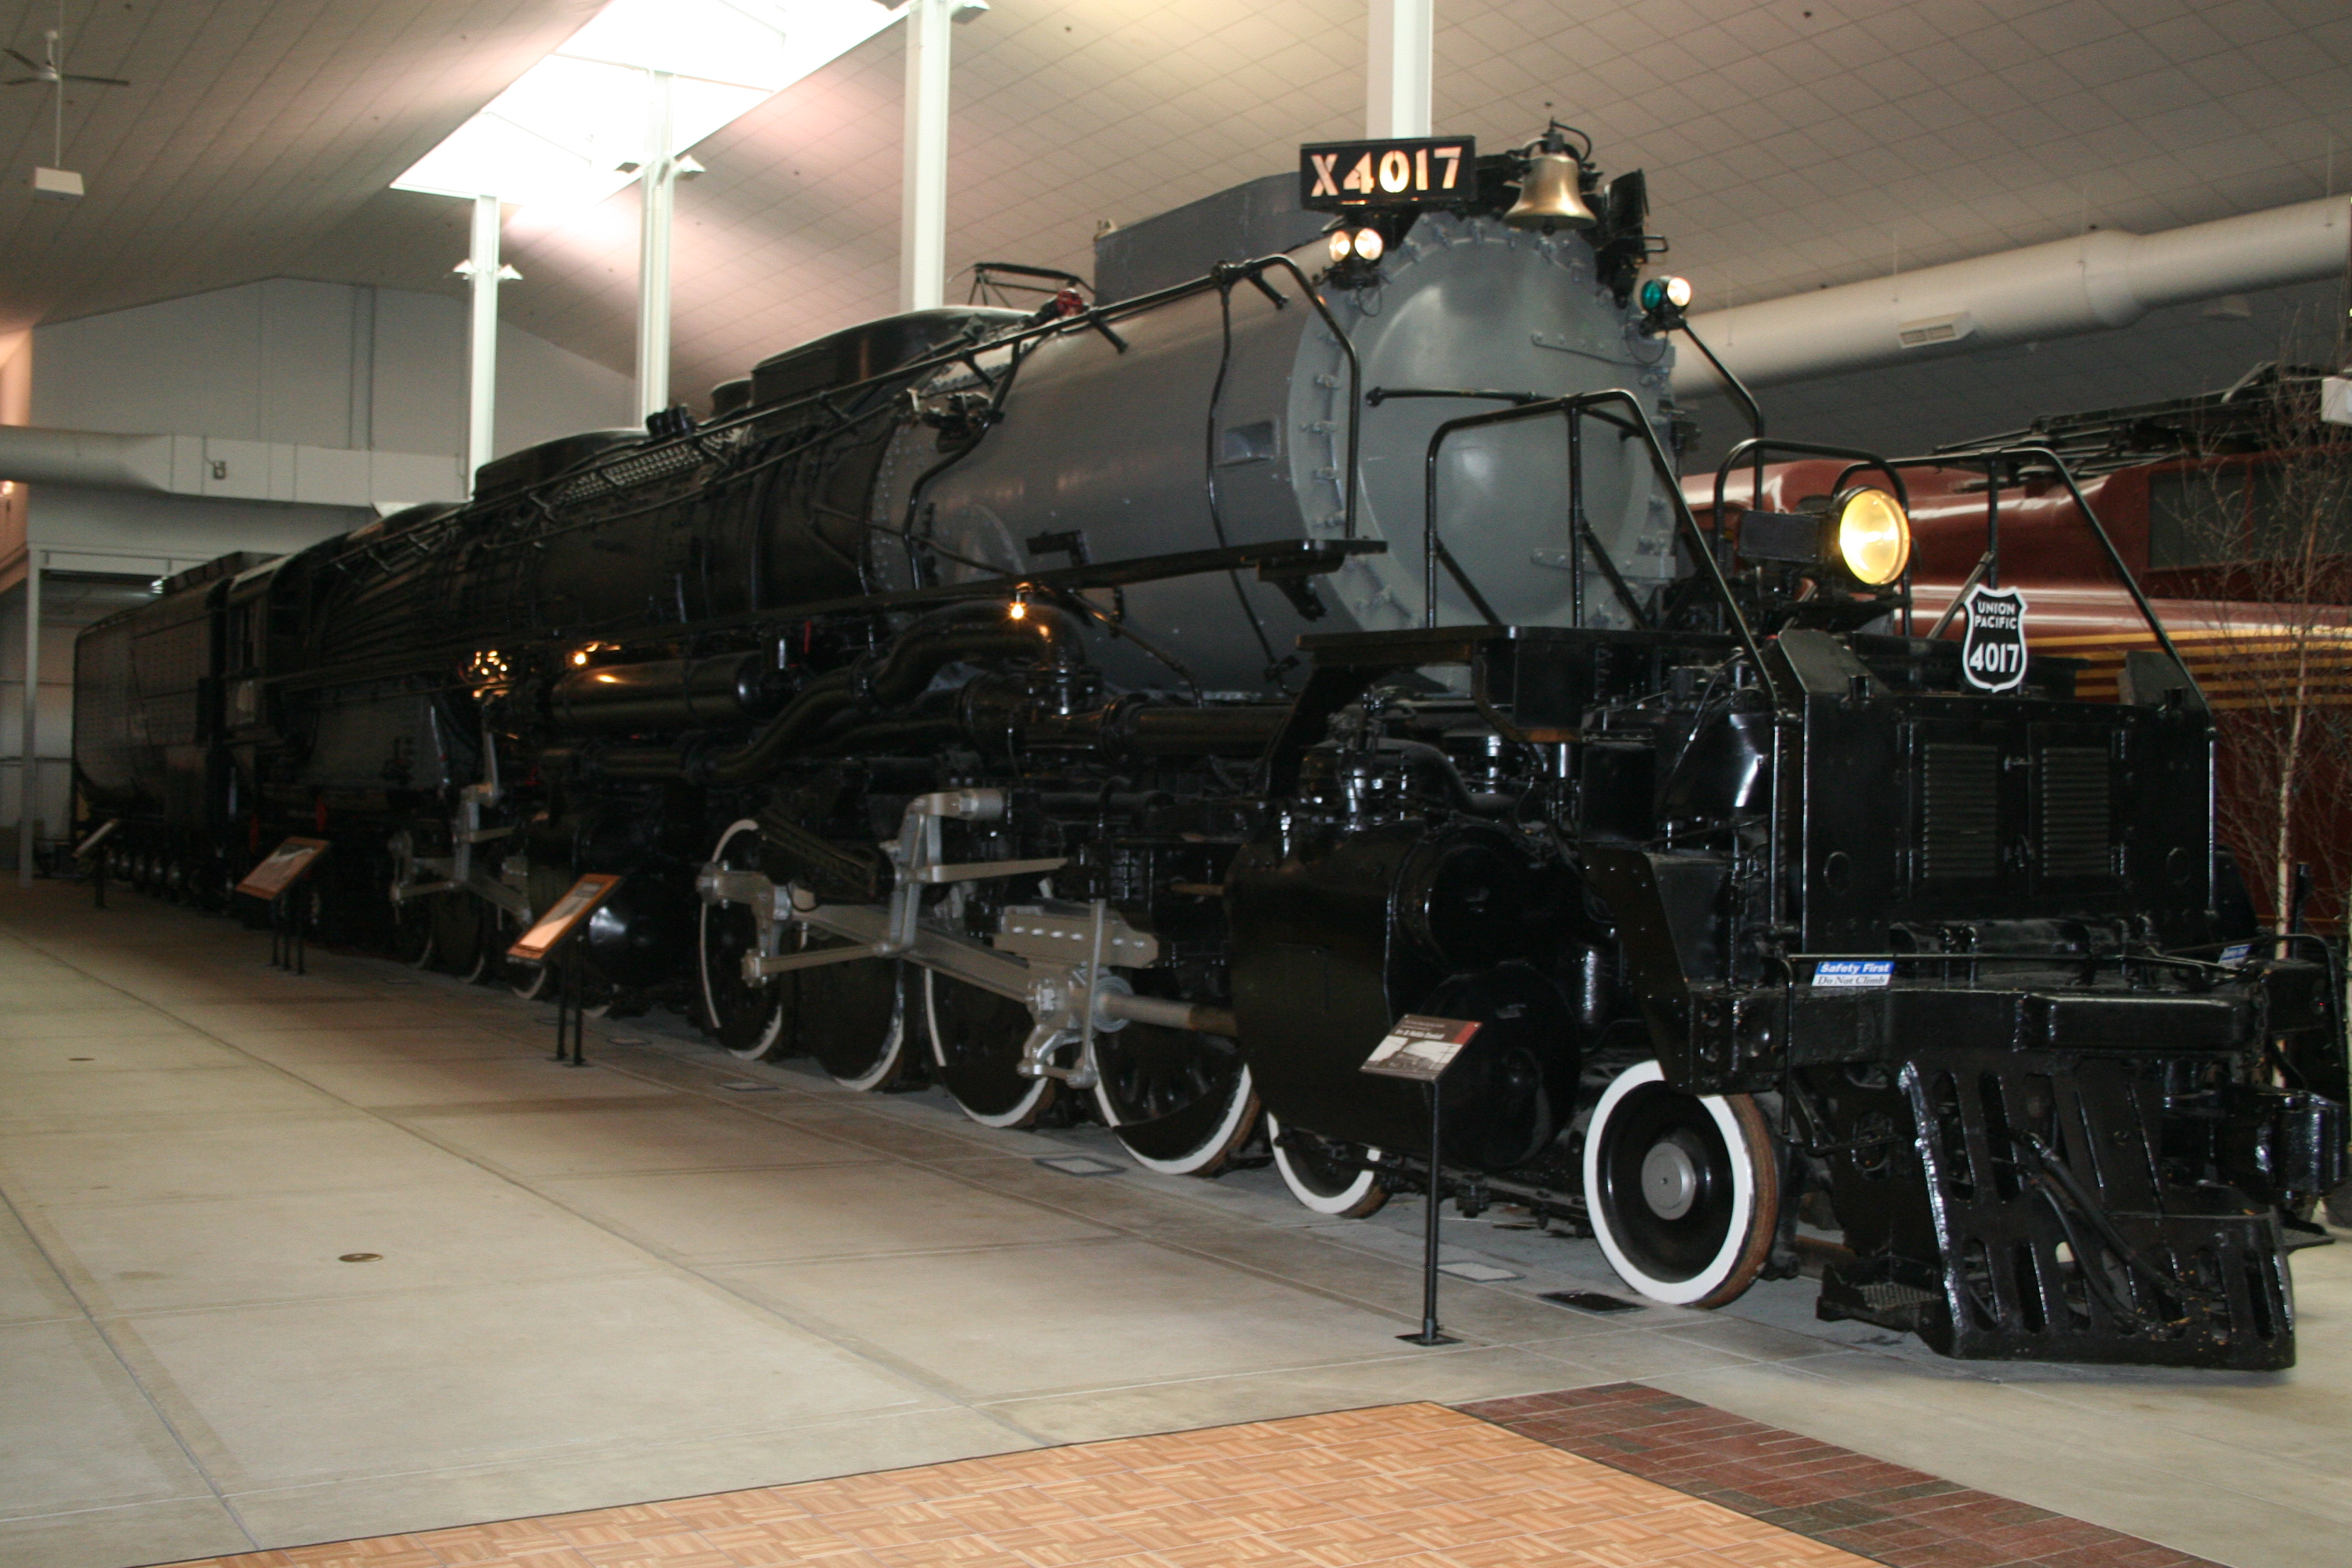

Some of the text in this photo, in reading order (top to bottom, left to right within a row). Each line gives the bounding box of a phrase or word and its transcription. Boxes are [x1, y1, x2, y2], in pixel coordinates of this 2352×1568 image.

[1977, 602, 2016, 615] UNION
[1974, 615, 2017, 630] PACIFIC
[1969, 642, 2020, 672] 4017
[1820, 962, 1891, 975] Safety First
[1817, 976, 1884, 985] Do Not Climb
